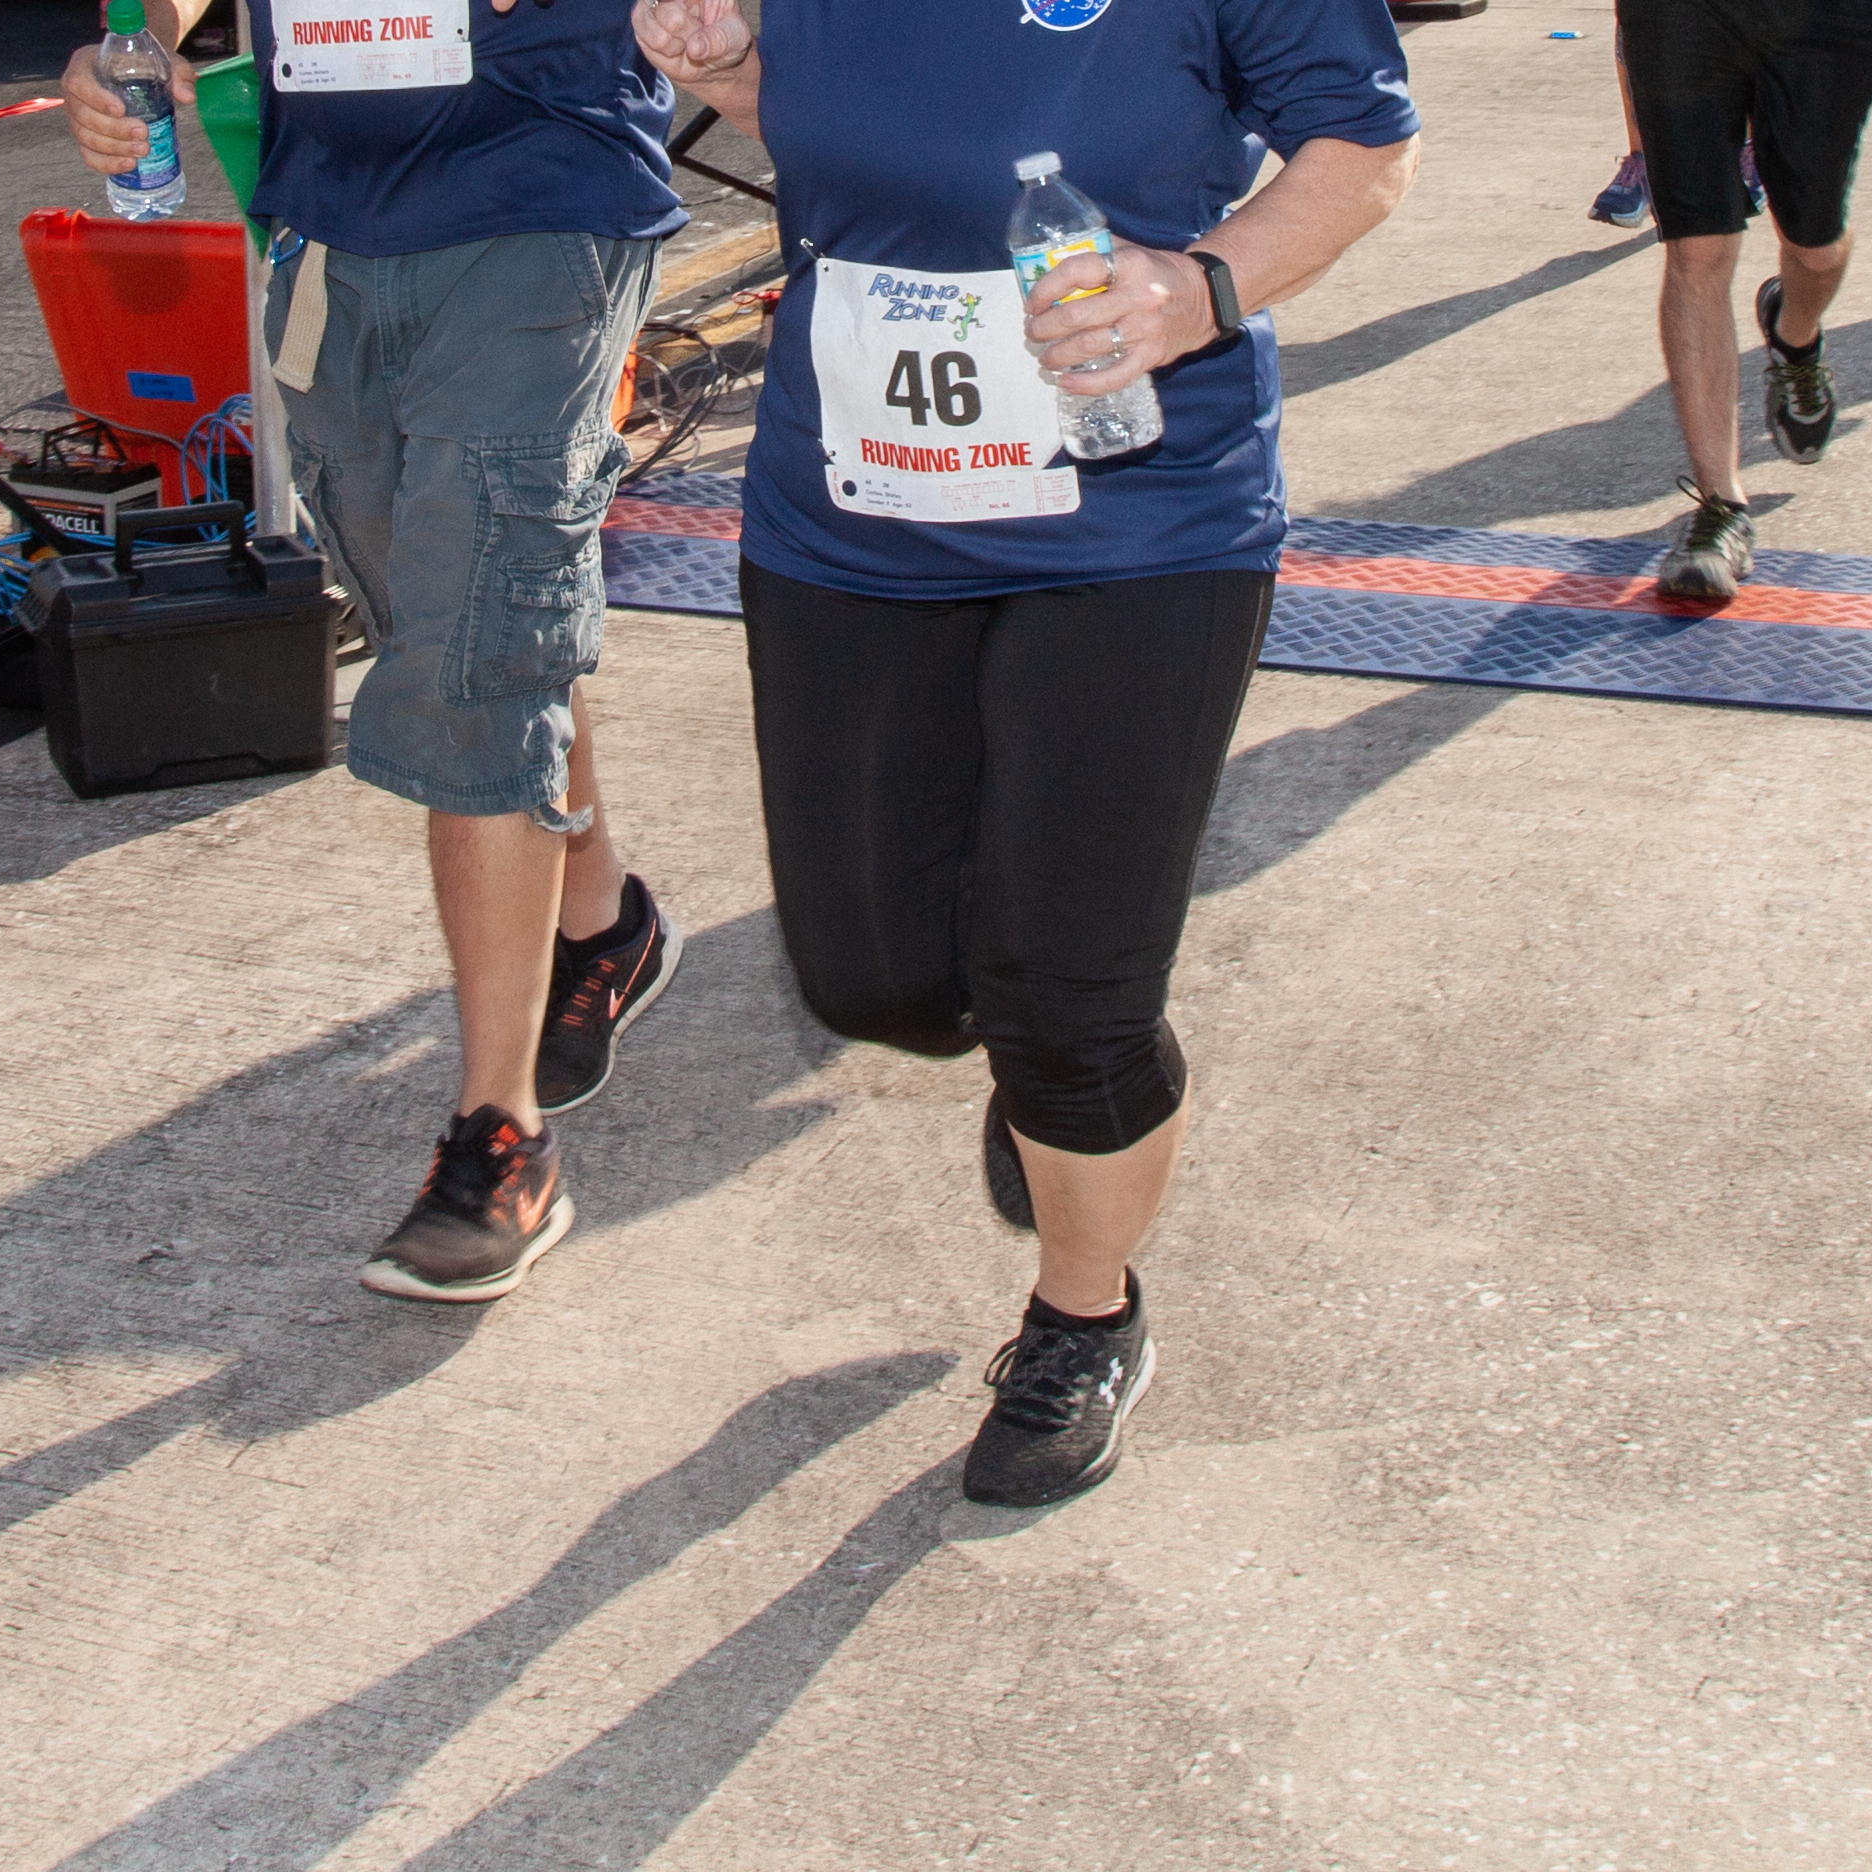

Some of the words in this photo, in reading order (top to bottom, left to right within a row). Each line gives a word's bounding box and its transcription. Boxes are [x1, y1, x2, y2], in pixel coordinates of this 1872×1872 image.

[293, 18, 373, 45] RUNNING
[379, 15, 434, 40] ZONE
[882, 297, 948, 322] ZONE
[885, 349, 982, 427] 46
[860, 437, 961, 473] RUNNING
[969, 441, 1034, 470] ZONE
